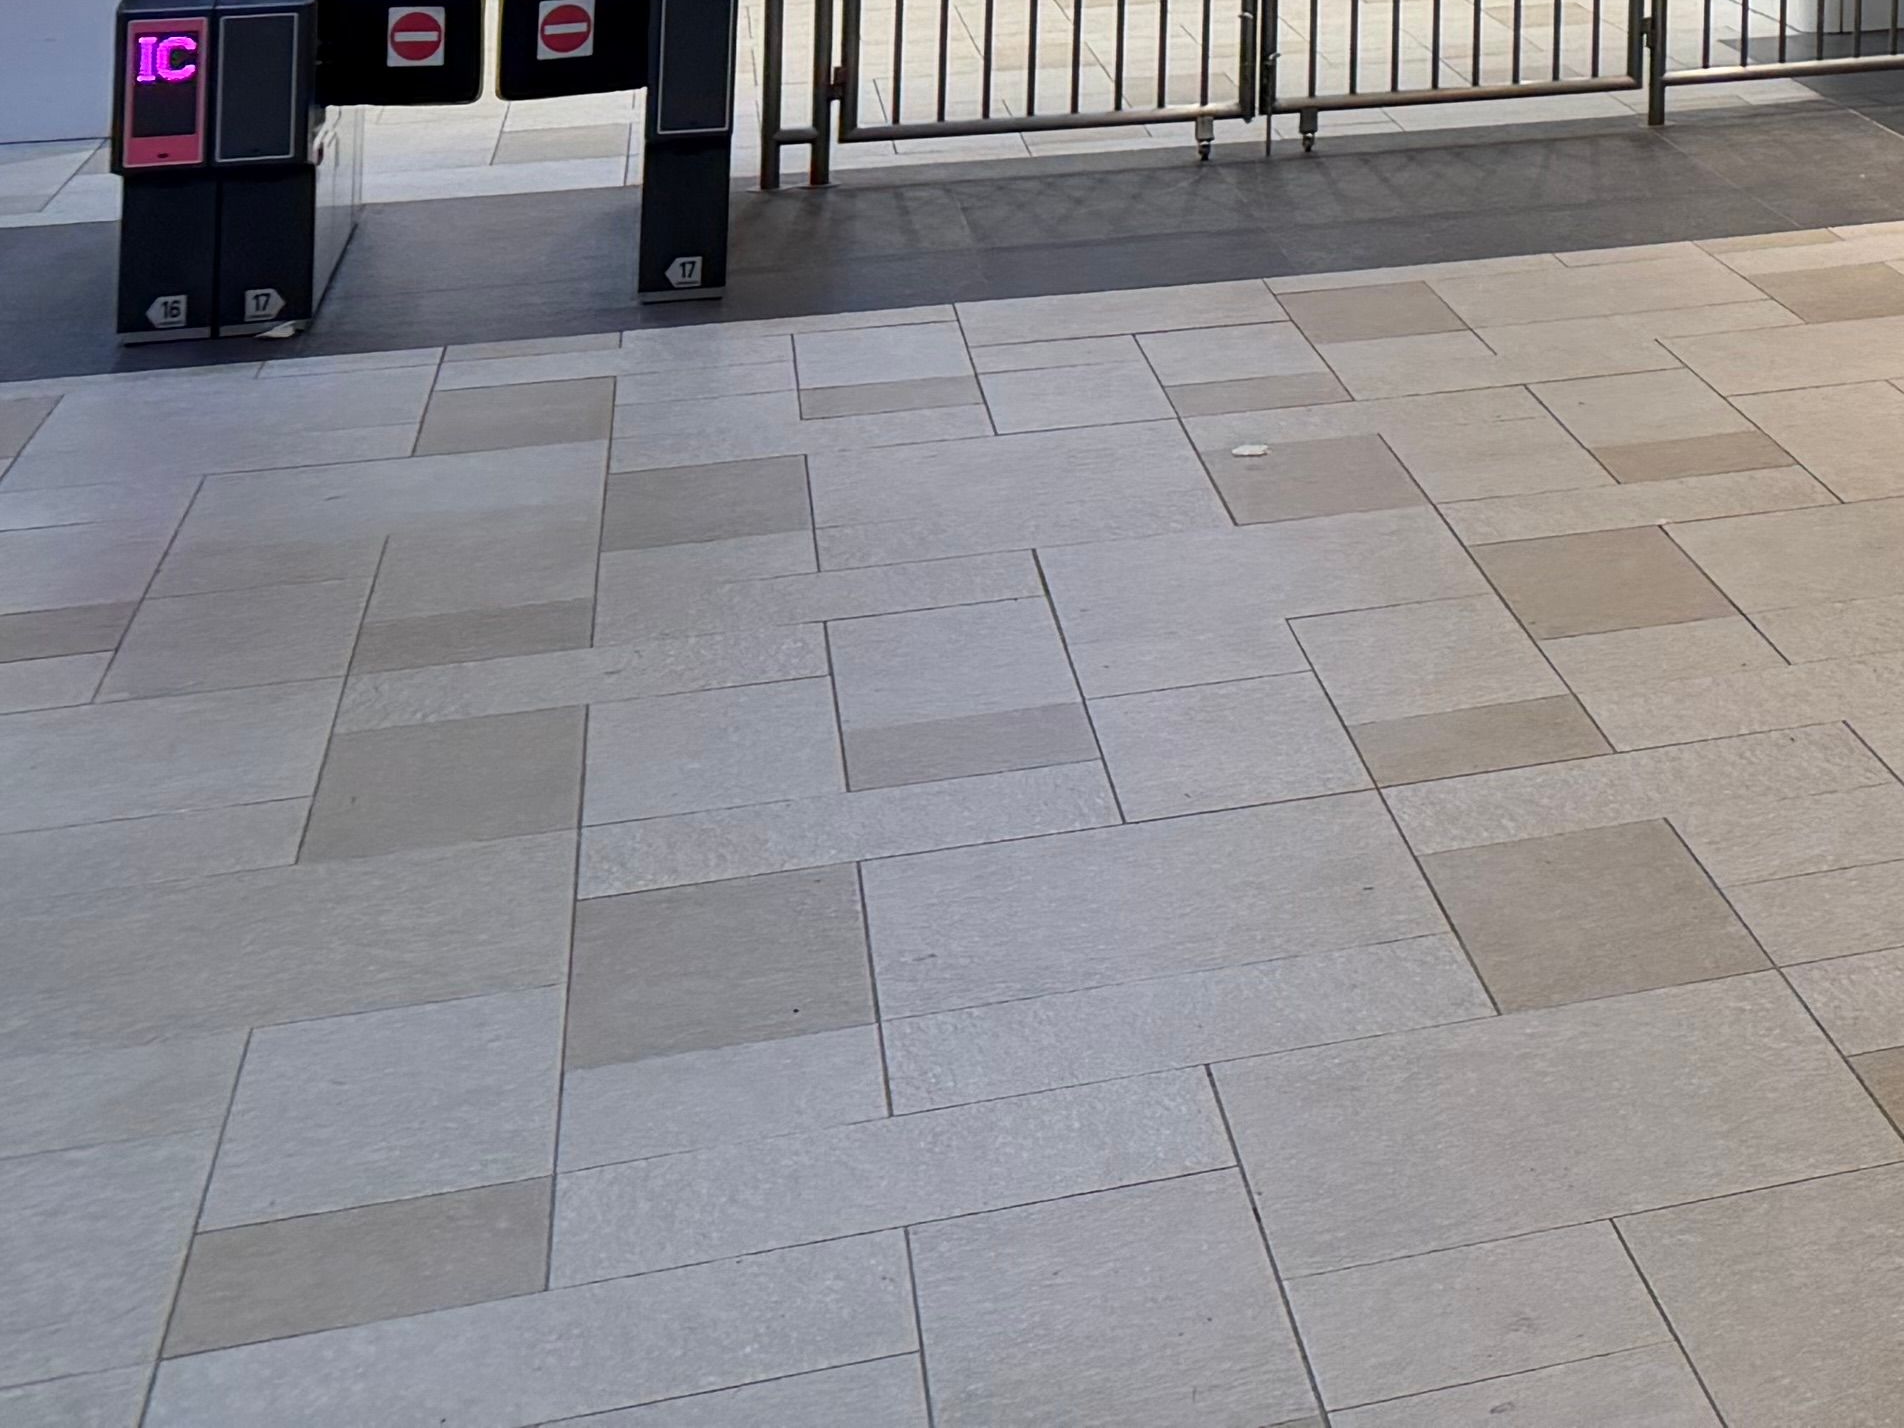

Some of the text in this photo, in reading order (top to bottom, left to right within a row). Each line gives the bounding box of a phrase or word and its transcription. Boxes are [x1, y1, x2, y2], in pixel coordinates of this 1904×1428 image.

[136, 36, 198, 82] IC
[679, 260, 697, 279] 17
[161, 300, 182, 319] 16
[252, 293, 272, 312] 17
